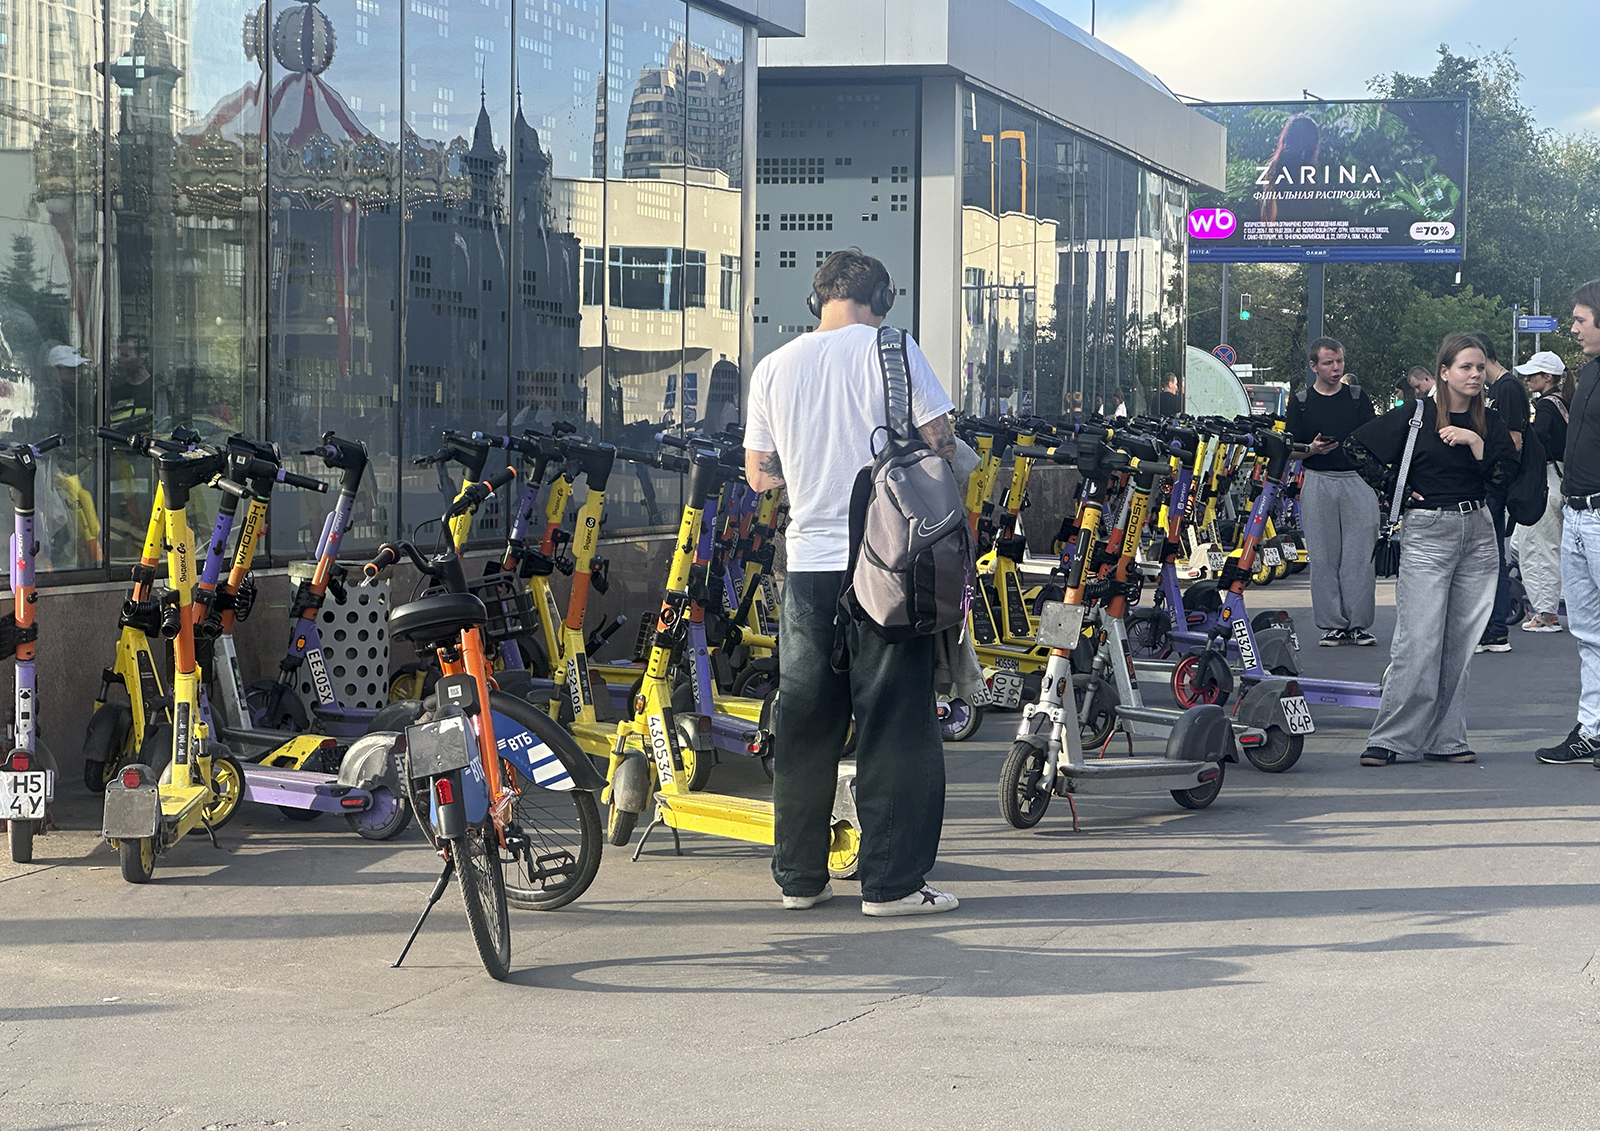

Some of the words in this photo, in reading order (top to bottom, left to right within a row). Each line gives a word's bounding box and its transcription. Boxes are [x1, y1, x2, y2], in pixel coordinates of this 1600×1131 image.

[1255, 165, 1381, 185] ZARINA
[1253, 190, 1315, 200] ФИНАЛЬНАЯ
[1316, 189, 1381, 199] РАСПРОДАЖА
[1190, 208, 1233, 232] wb
[1258, 495, 1267, 514] ЮРЕНТ
[237, 505, 260, 565] WHOOSH
[1124, 496, 1143, 553] WHOOSH
[177, 542, 187, 554] Go
[583, 529, 593, 550] Яндекс
[1233, 620, 1257, 670] ЕН327М
[309, 651, 333, 702] ЕЕ305Х
[567, 659, 582, 714] 252108
[1282, 699, 1309, 716] КХ1
[1289, 716, 1311, 732] 64Р
[507, 731, 533, 752] ВТБ
[649, 716, 674, 783] 430534
[1569, 740, 1592, 757] N
